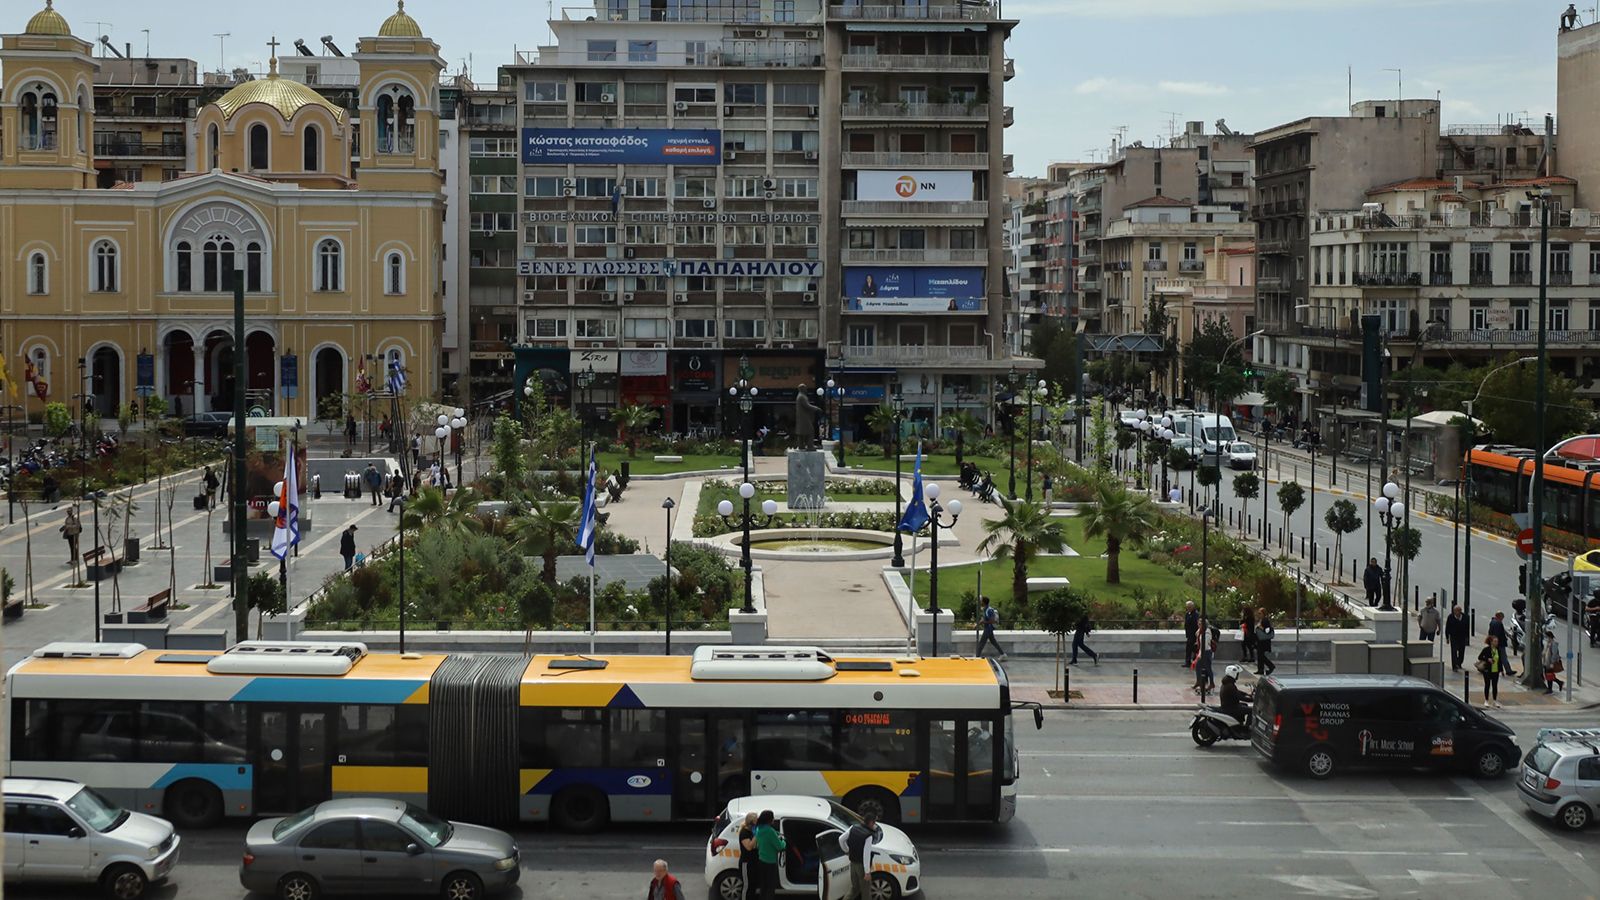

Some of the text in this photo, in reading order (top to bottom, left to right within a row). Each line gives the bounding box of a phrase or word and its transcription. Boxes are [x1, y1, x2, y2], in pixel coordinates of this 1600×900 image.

[529, 134, 648, 147] κώστας κατσαφάδος
[920, 182, 936, 190] NN
[529, 212, 618, 222] ΒΙΟΤΕΧΝΙΚΟΝ
[750, 213, 811, 223] ΠΕΙΡΑΙΩΣ
[520, 262, 819, 275] ΞΕΝΕΣ ΓΛΩΣΣΕΣ ΠΑΠΑΗΛΙΟΥ
[845, 715, 864, 724] 040
[1380, 739, 1396, 750] Music
[1397, 739, 1415, 751] School
